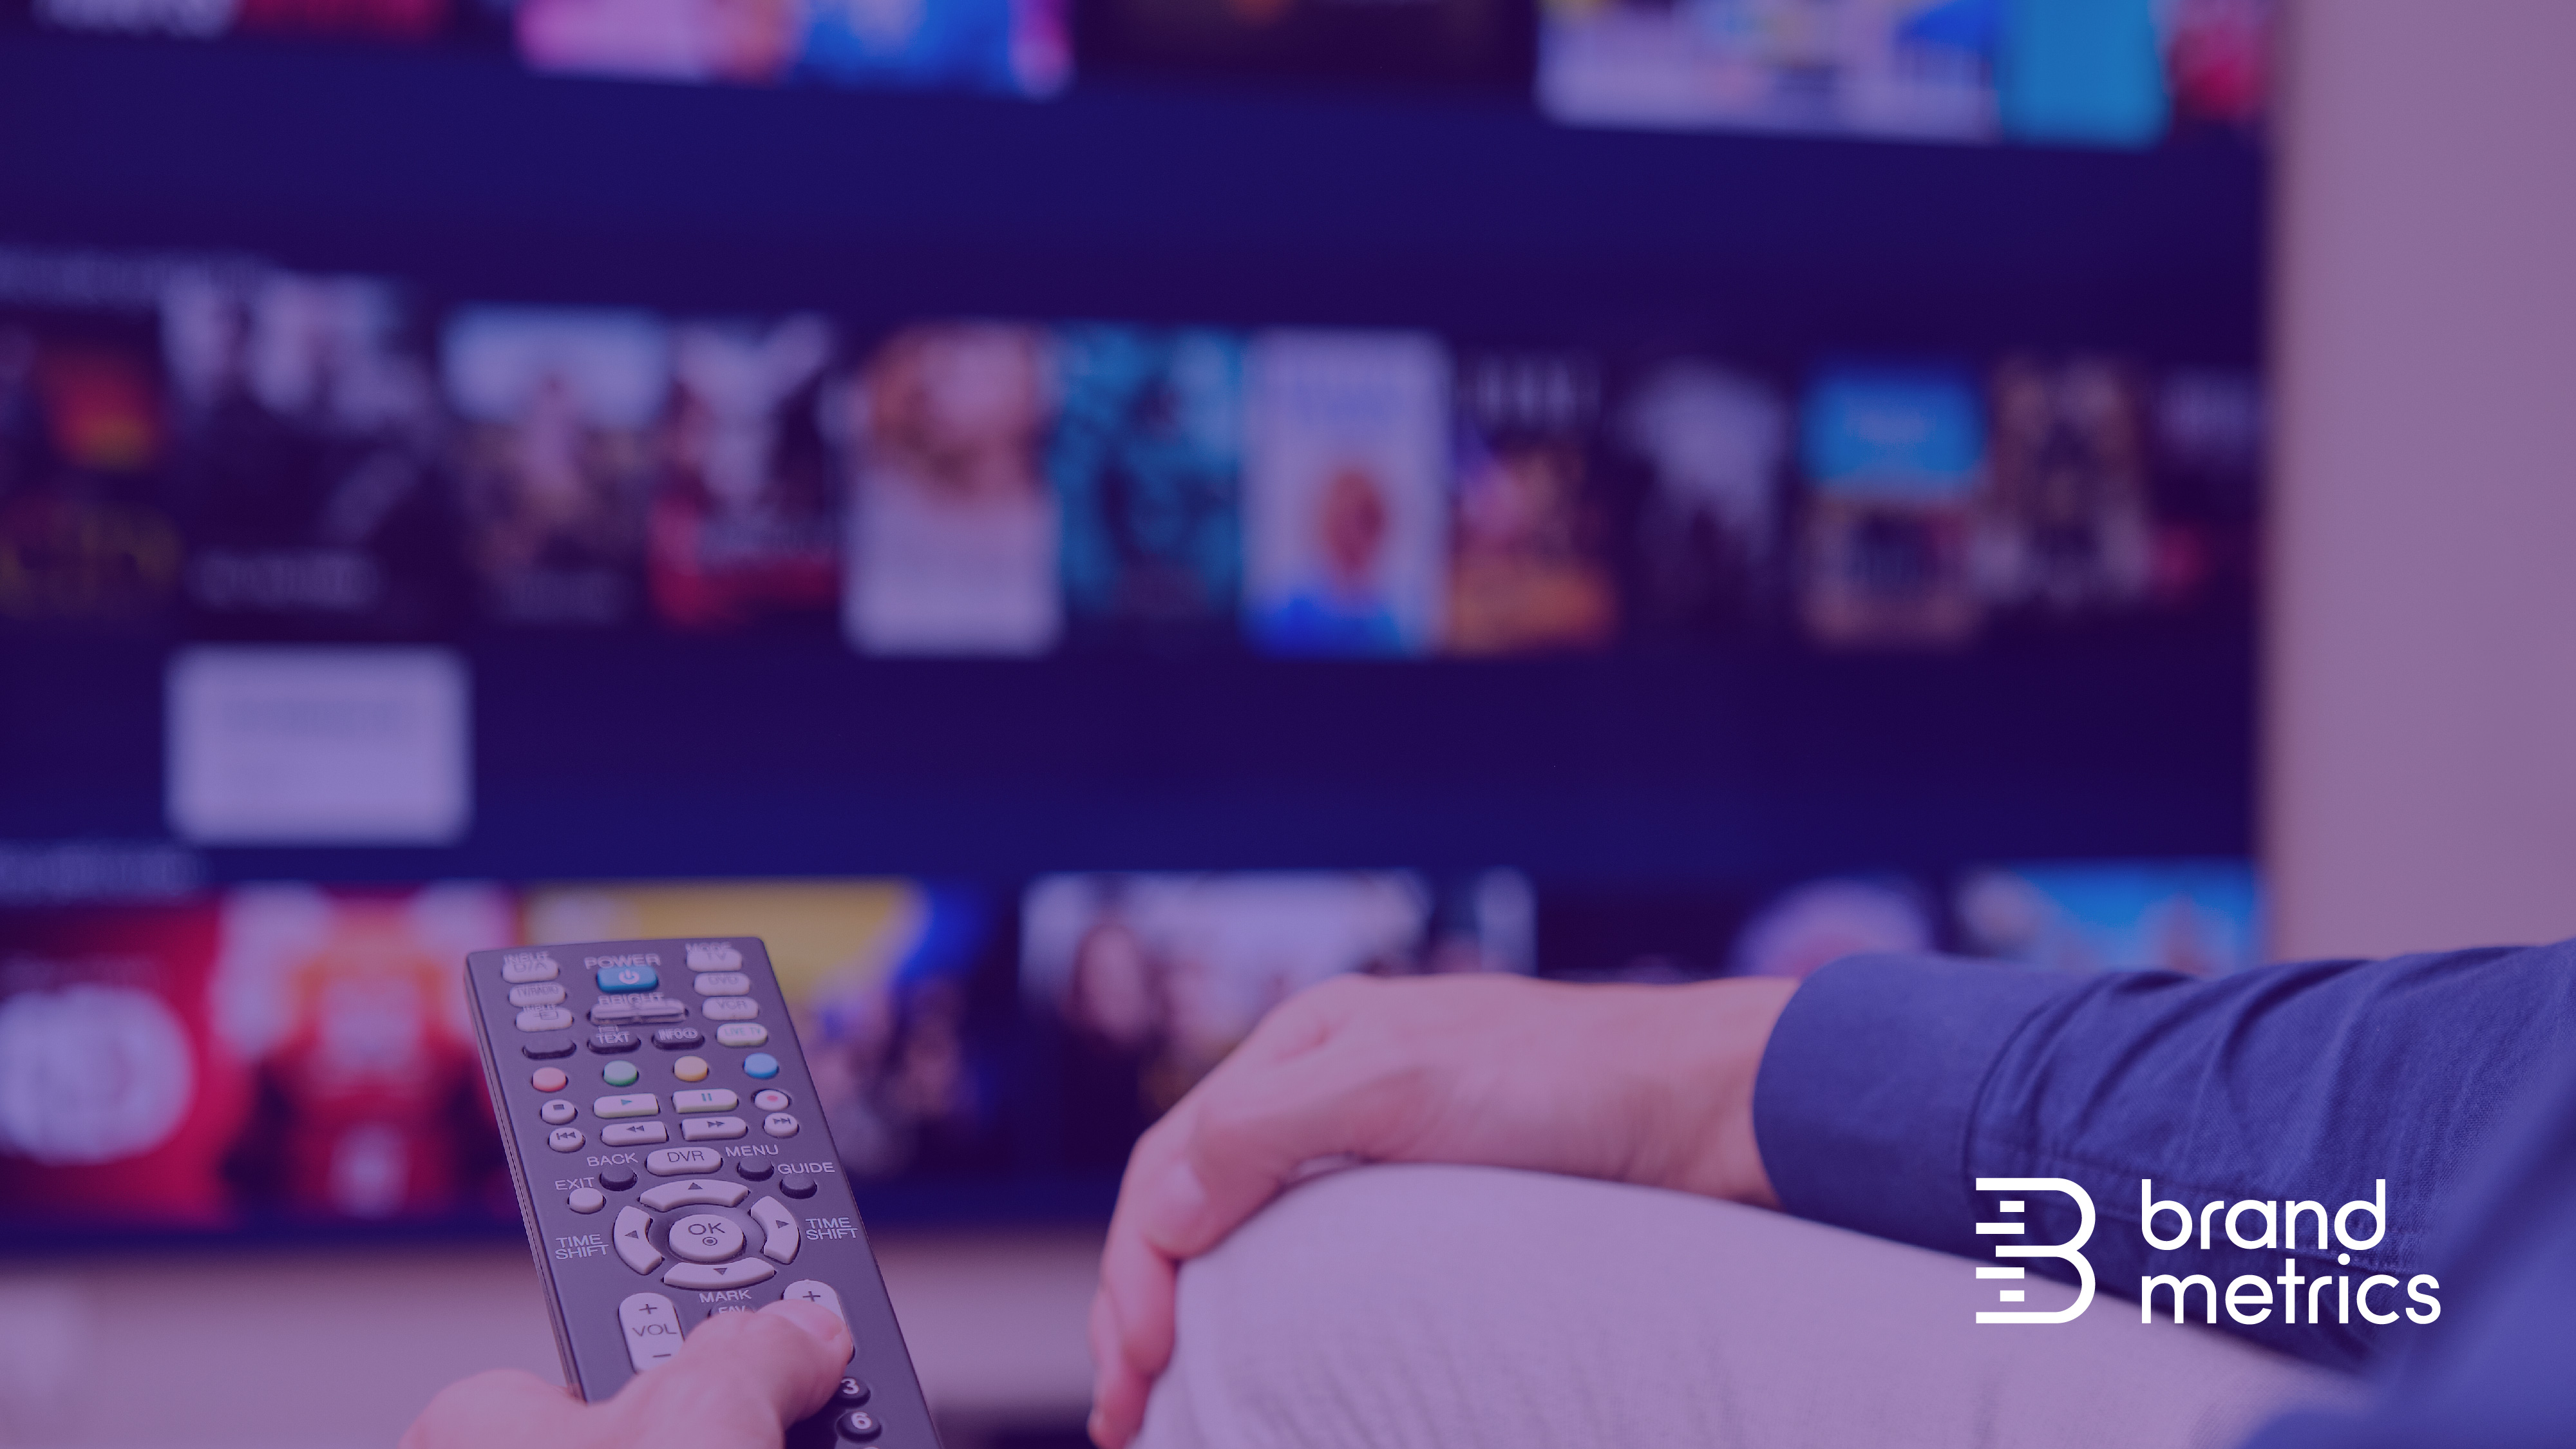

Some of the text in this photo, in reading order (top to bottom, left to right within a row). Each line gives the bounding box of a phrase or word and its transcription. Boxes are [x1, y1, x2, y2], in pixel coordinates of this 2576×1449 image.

[584, 953, 661, 970] POWER
[715, 999, 748, 1010] VCR
[596, 1031, 630, 1044] TEXT
[658, 1028, 683, 1041] INFO
[667, 1150, 705, 1162] DVR
[725, 1144, 779, 1157] MENU
[587, 1152, 639, 1167] BACK
[777, 1162, 835, 1175] GUIDE
[554, 1177, 595, 1191] EXIT
[688, 1222, 726, 1235] OK
[805, 1217, 852, 1229] TIME
[806, 1227, 858, 1240] SHIFT
[555, 1234, 603, 1249] TIME
[555, 1244, 609, 1260] SHIFT
[699, 1289, 752, 1303] MARK
[632, 1323, 677, 1337] VOL
[841, 1378, 860, 1395] 3
[851, 1411, 872, 1430] 6
